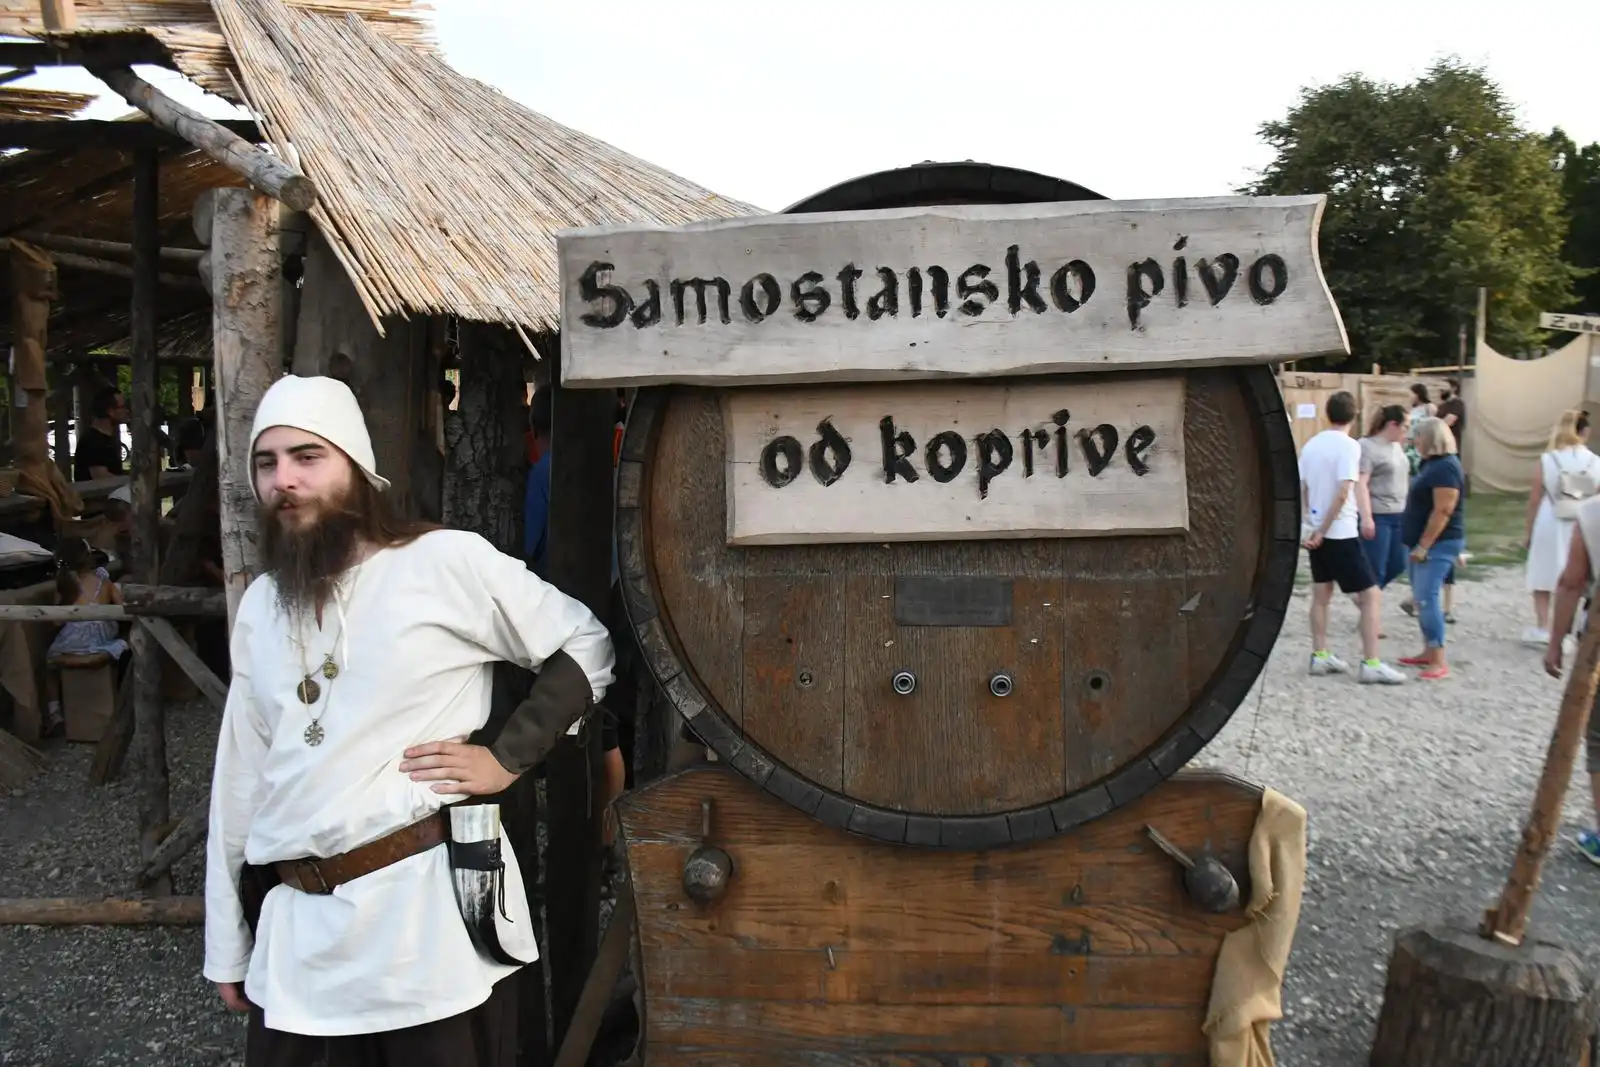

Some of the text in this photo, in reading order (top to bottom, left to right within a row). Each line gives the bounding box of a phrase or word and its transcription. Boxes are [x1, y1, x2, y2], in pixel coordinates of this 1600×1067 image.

[580, 235, 1290, 330] Samostansko pivo
[759, 409, 1156, 500] od koprive
